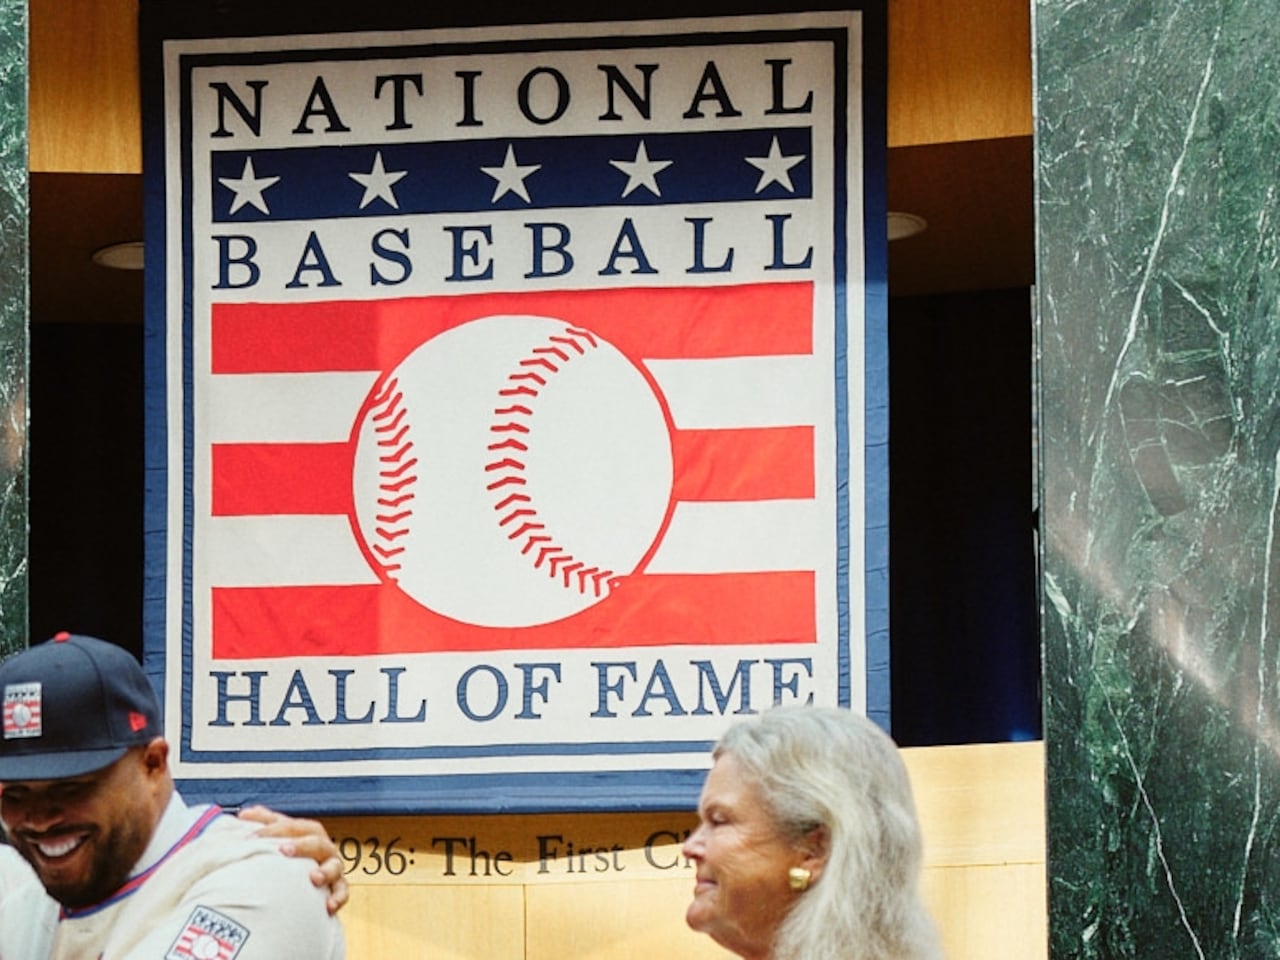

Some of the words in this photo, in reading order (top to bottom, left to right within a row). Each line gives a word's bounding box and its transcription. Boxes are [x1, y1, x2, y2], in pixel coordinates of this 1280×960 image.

[209, 58, 814, 139] NATIONAL
[211, 213, 814, 290] BASEBALL
[208, 666, 427, 727] HALL
[456, 661, 562, 722] OF
[590, 657, 814, 719] FAME
[331, 836, 415, 875] 936:
[432, 836, 513, 876] The
[536, 834, 625, 874] First
